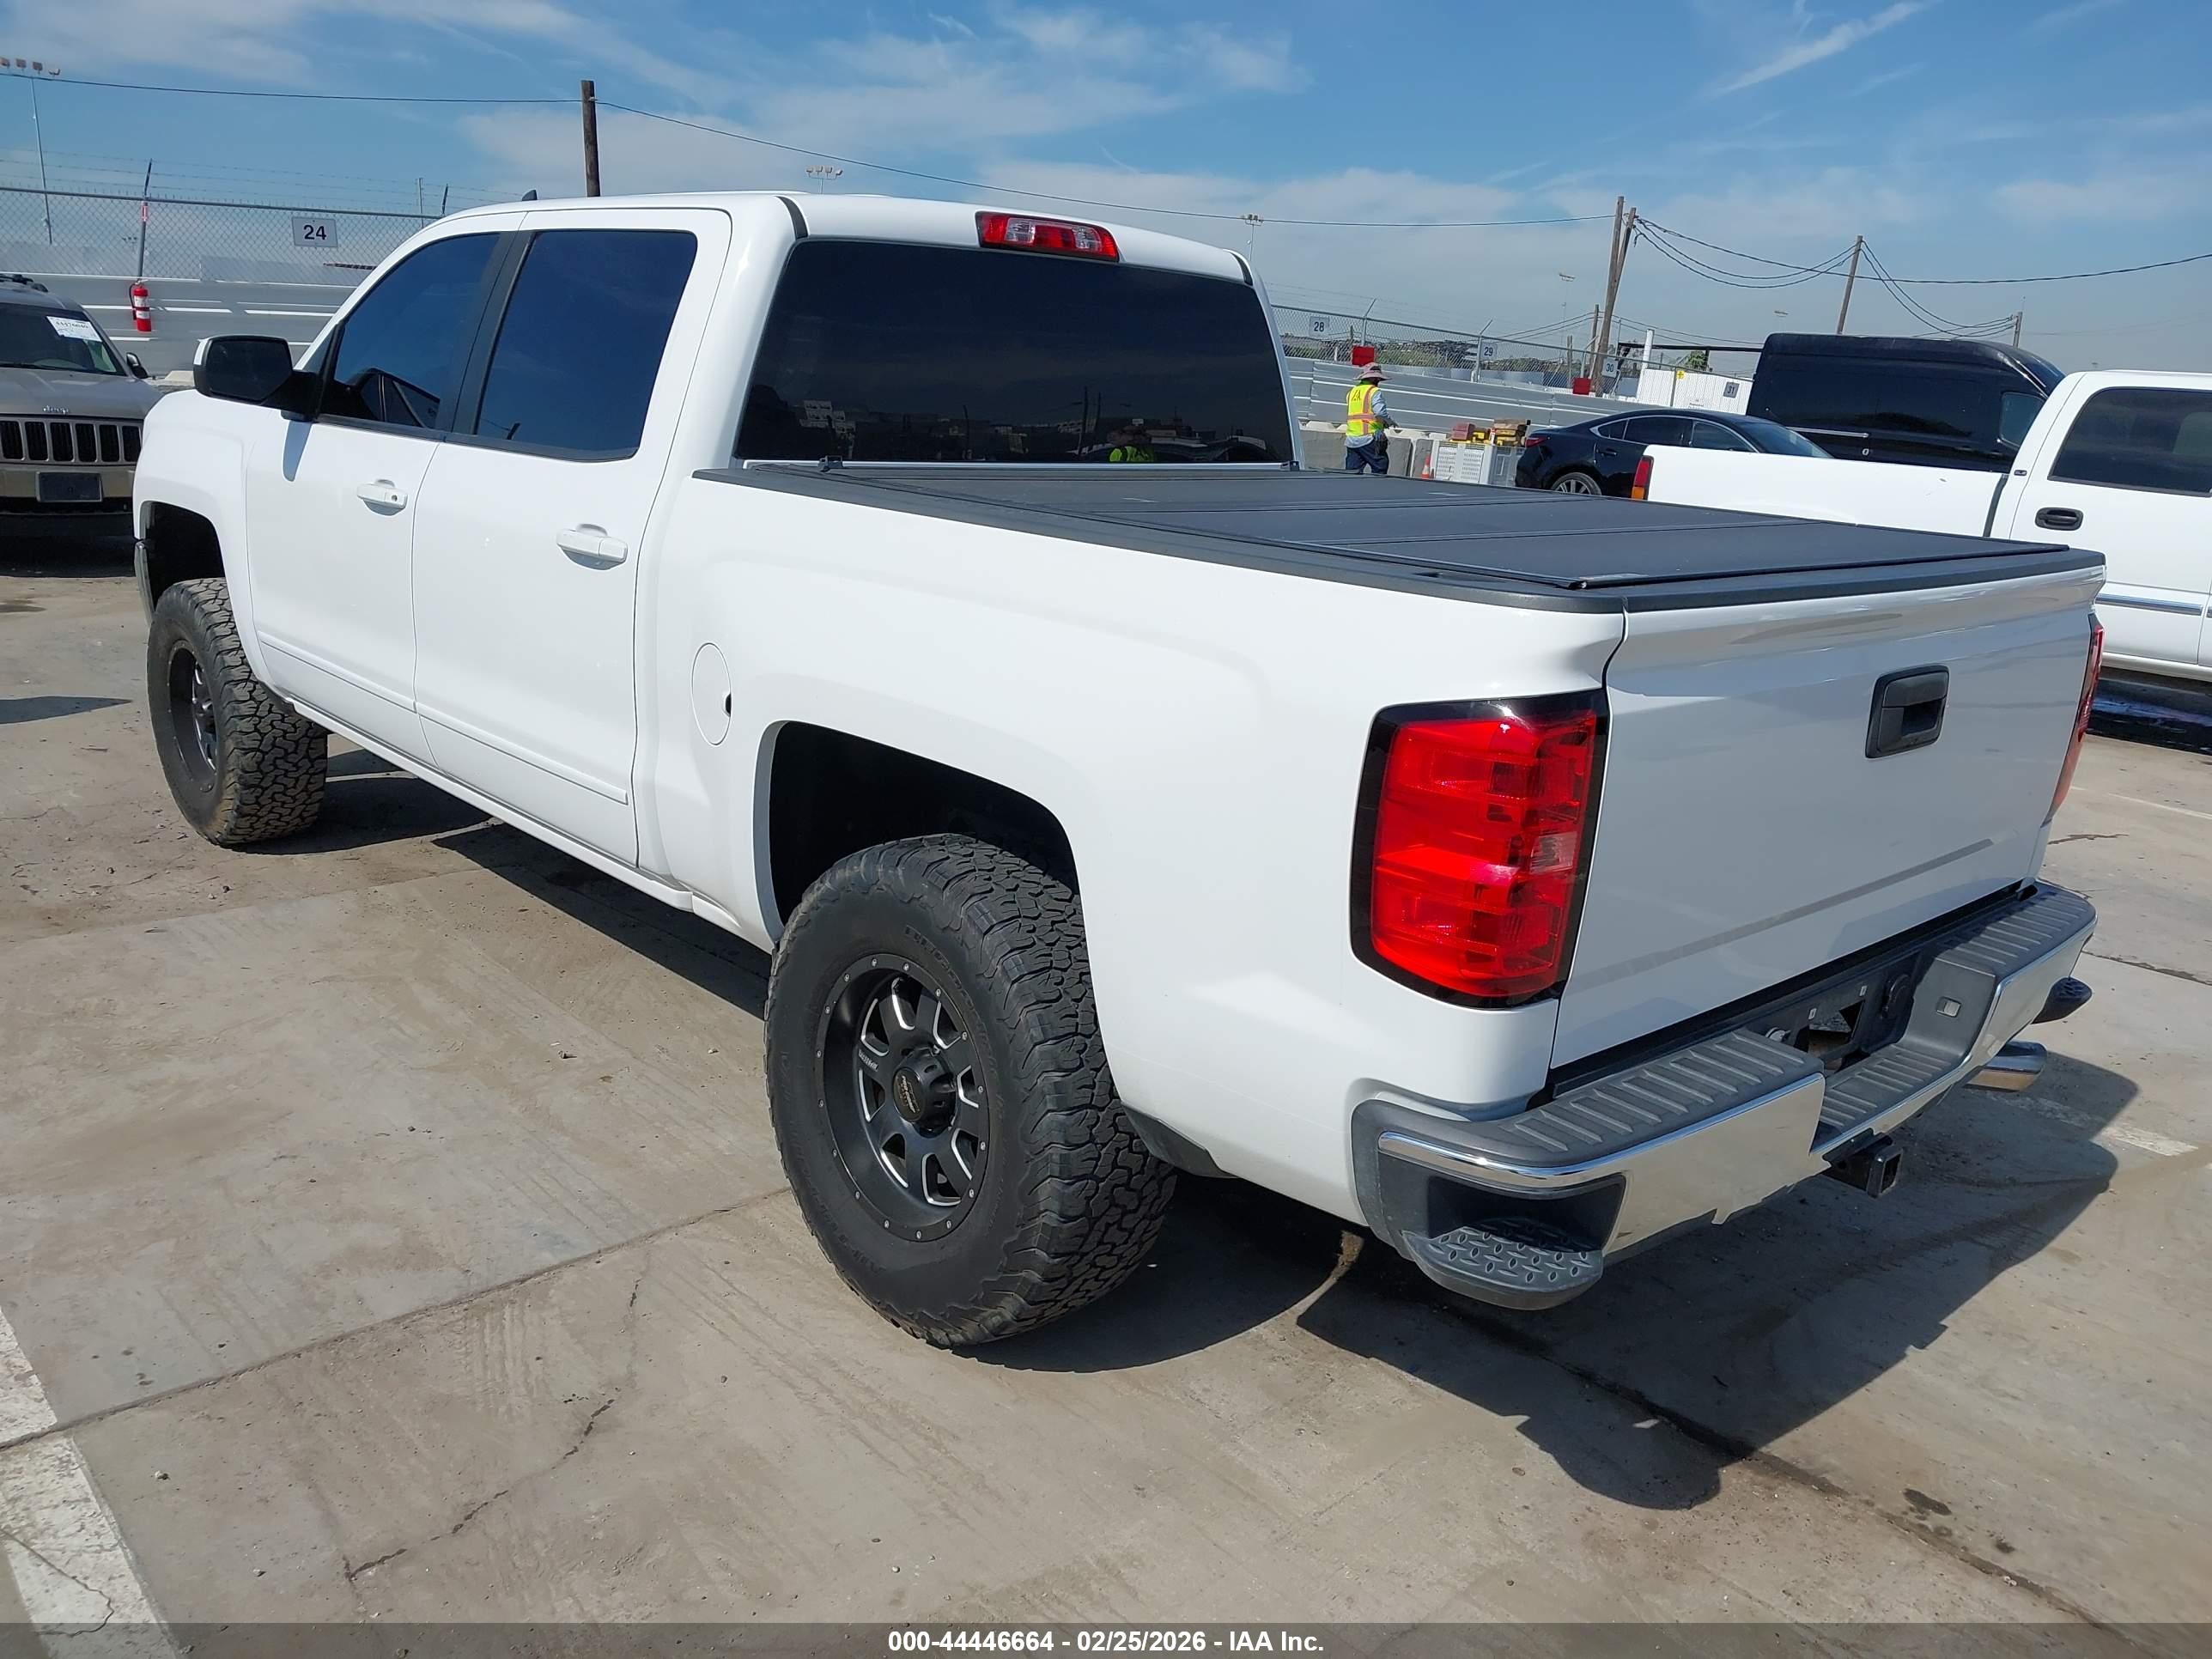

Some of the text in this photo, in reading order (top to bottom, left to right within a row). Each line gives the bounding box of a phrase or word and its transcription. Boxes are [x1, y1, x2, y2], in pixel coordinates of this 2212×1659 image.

[303, 224, 327, 240] 24
[1314, 321, 1325, 332] 28
[1484, 346, 1493, 356] 29
[1606, 362, 1614, 373] 30
[1727, 385, 1735, 394] 31
